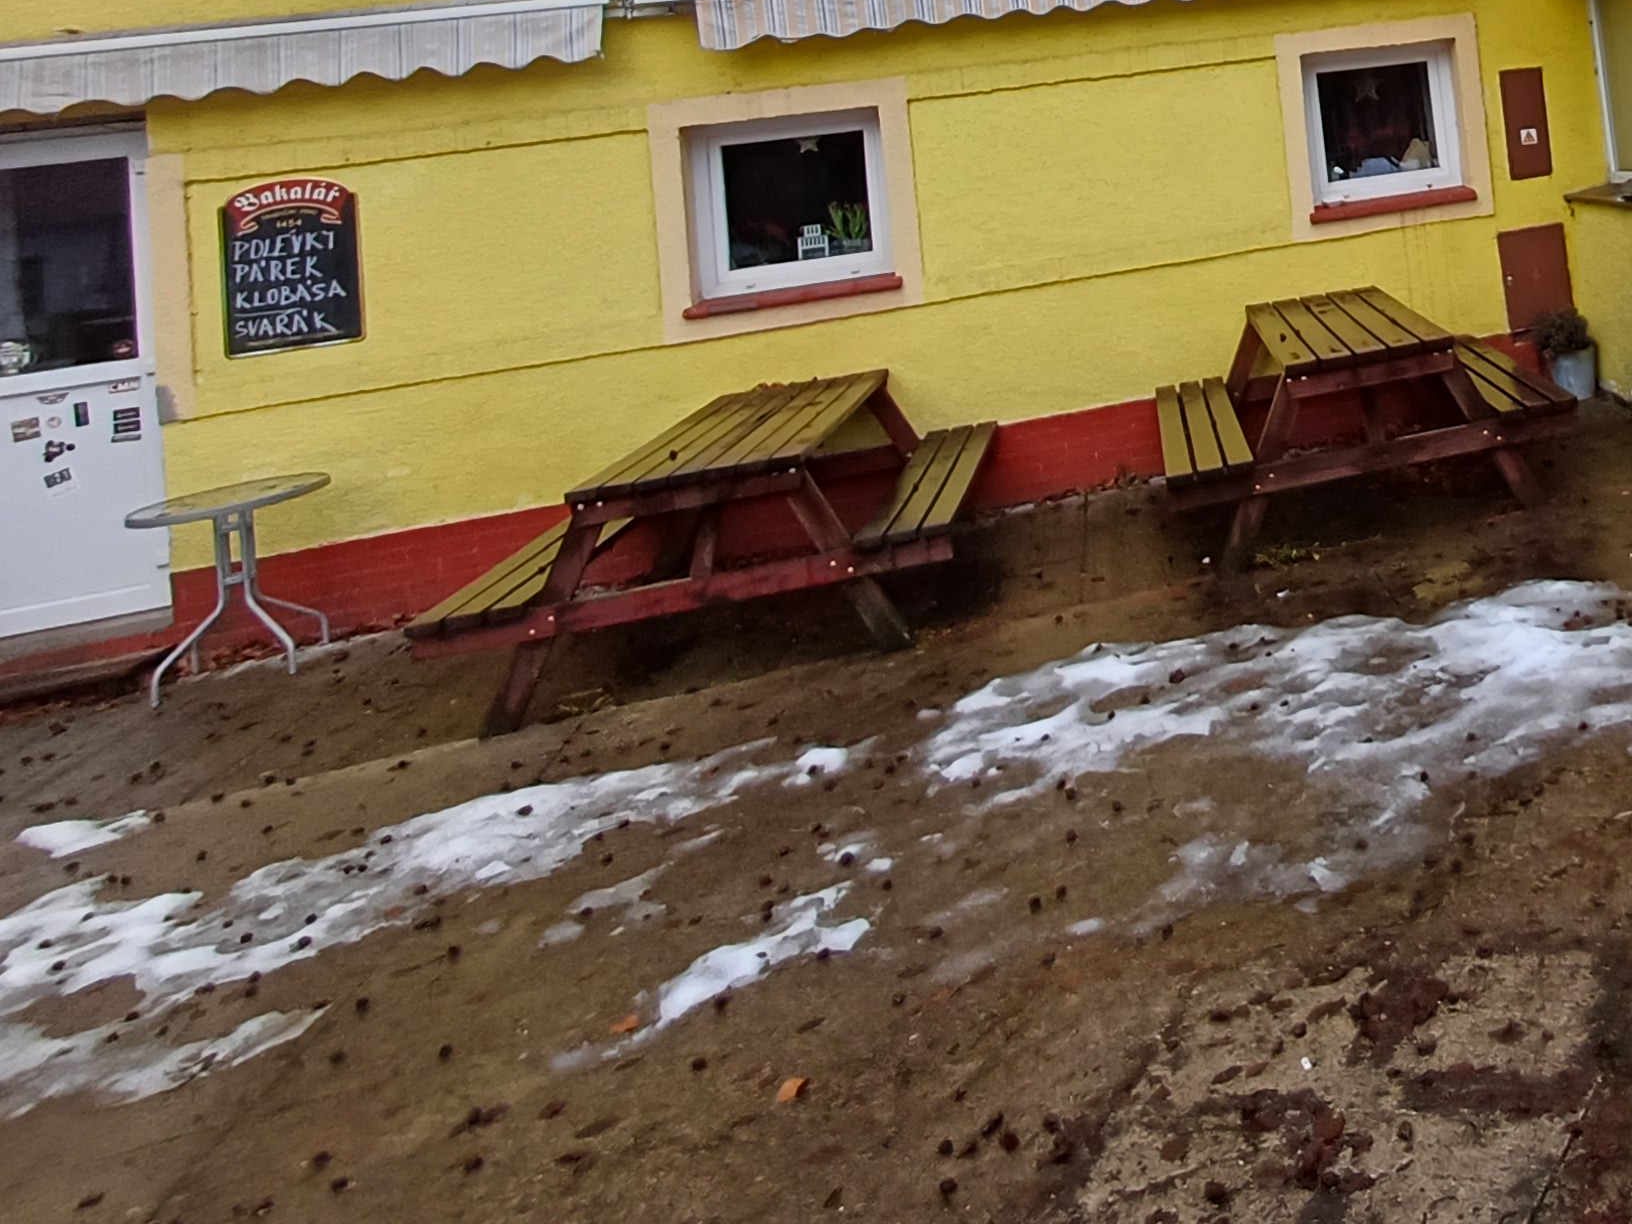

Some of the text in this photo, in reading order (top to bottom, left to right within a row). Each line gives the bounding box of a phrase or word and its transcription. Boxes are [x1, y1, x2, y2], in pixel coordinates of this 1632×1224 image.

[234, 182, 341, 212] Bakalář
[232, 255, 324, 284] PÁREK
[235, 279, 347, 309] KLOBÁSA
